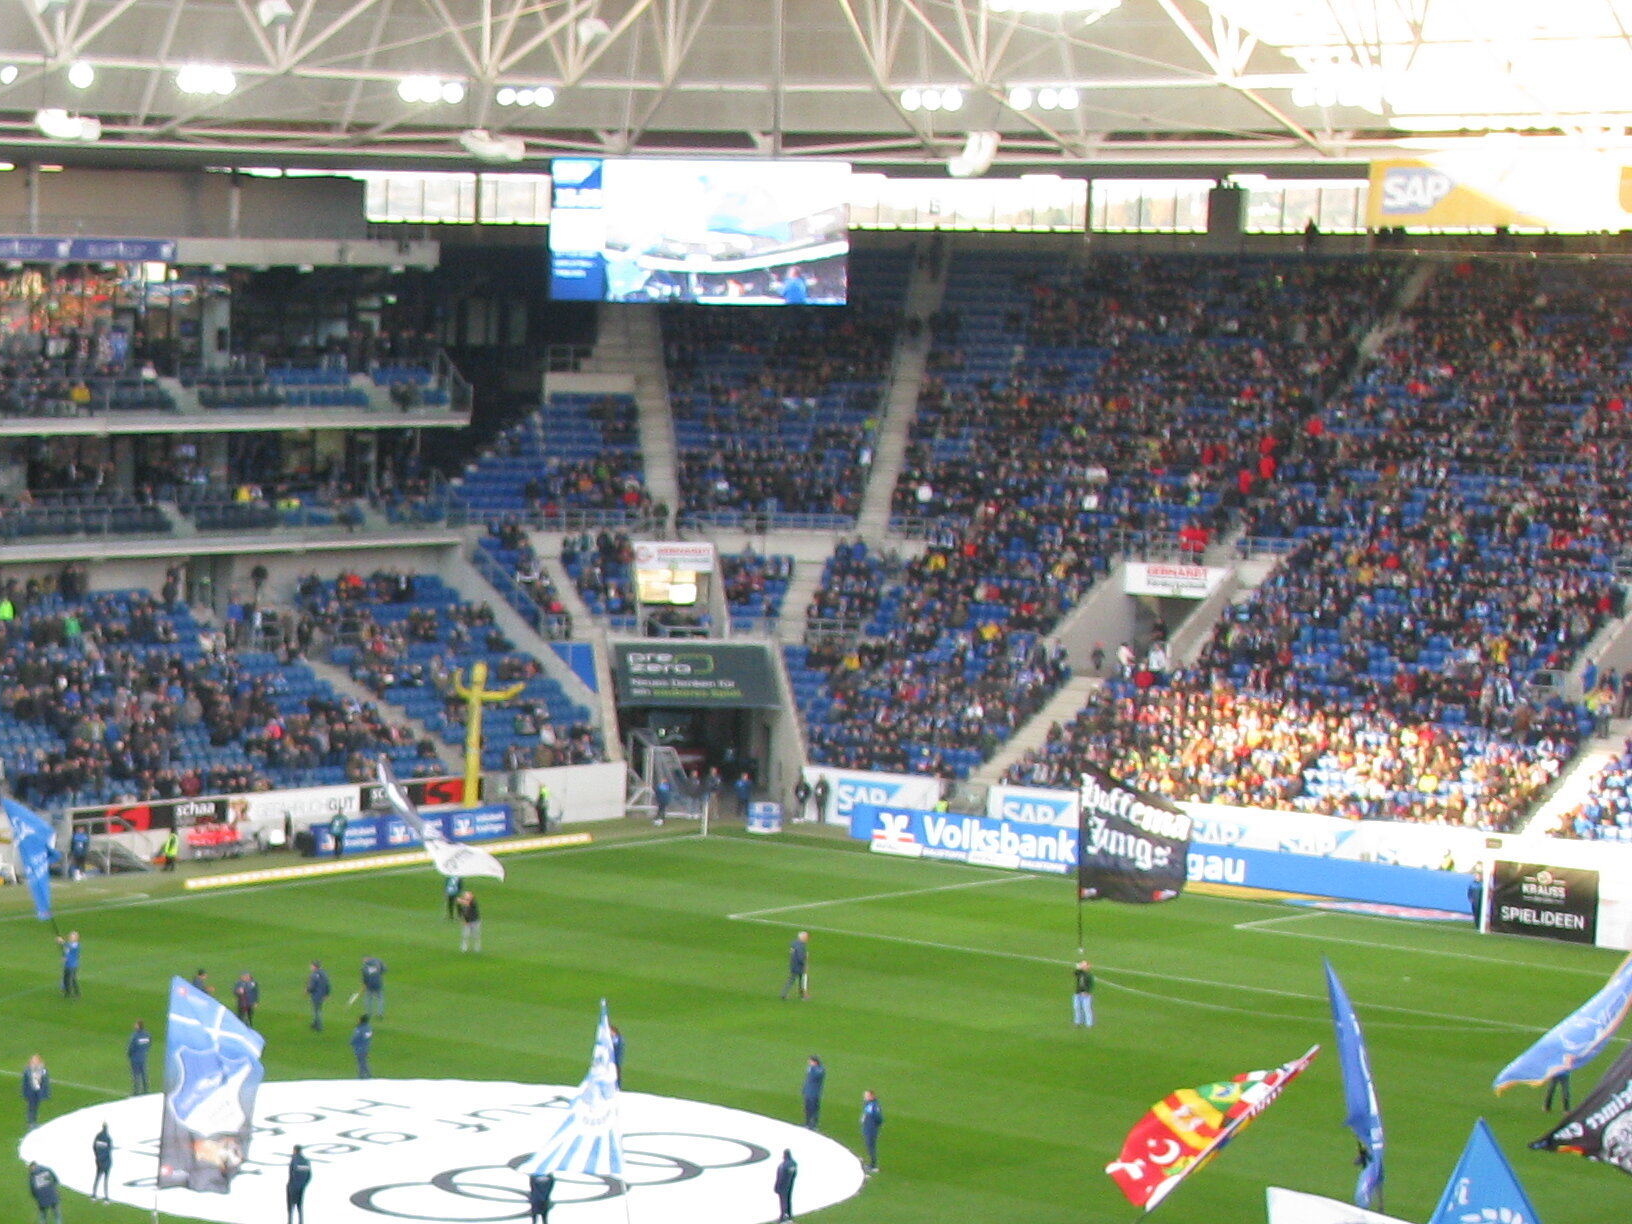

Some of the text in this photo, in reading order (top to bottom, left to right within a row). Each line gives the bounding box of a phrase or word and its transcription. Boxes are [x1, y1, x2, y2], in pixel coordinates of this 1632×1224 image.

[1384, 174, 1451, 208] SAP
[628, 653, 672, 665] pre
[629, 662, 692, 675] zero
[924, 815, 1246, 883] Volksbank gau
[1521, 883, 1566, 899] KRAUSS
[1500, 905, 1585, 931] SPIELIDEEN
